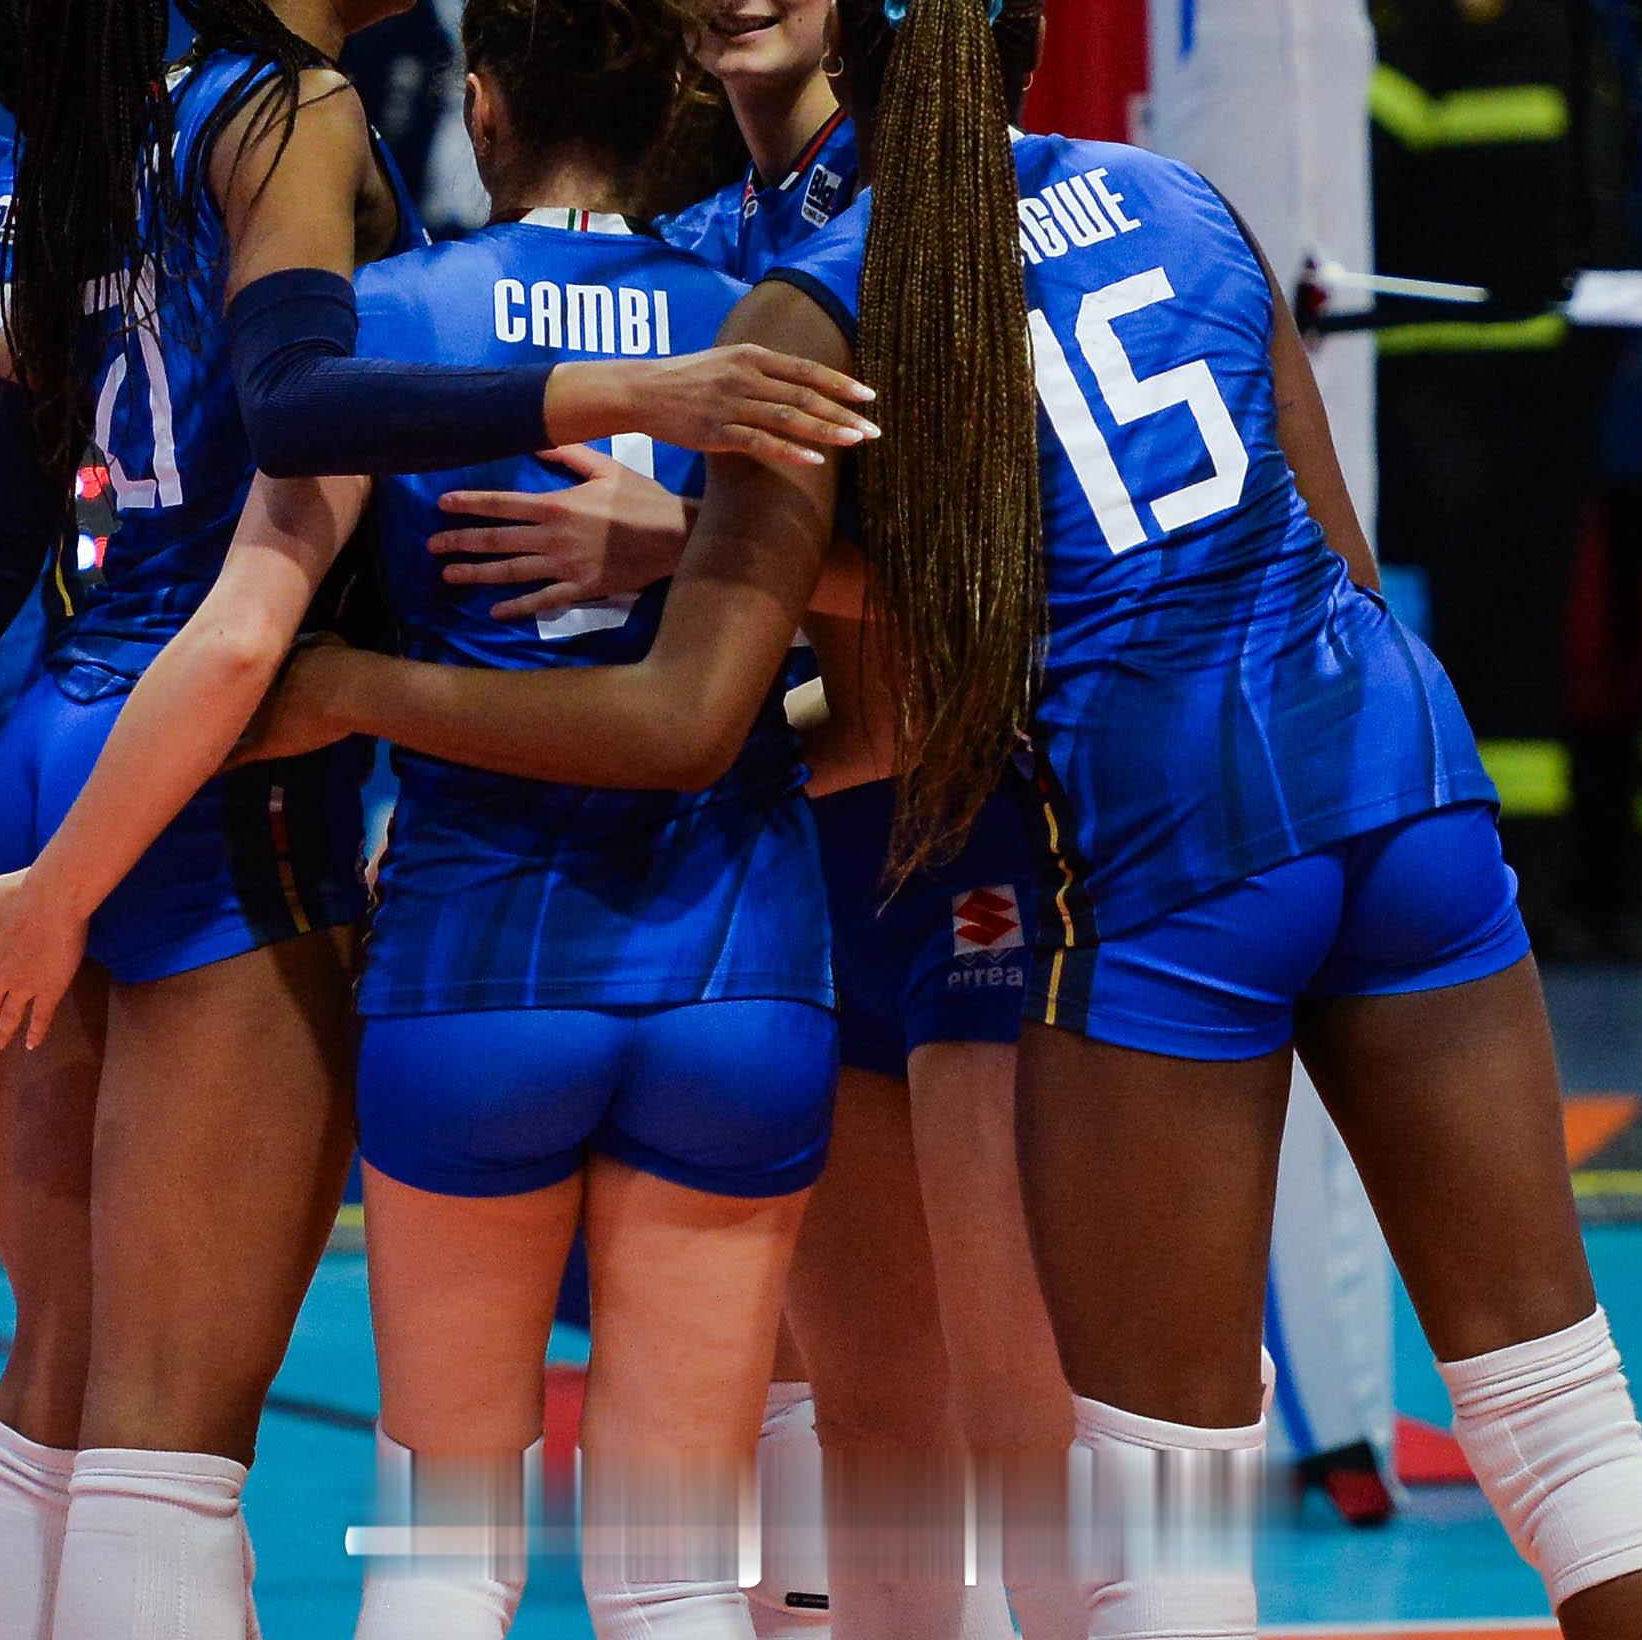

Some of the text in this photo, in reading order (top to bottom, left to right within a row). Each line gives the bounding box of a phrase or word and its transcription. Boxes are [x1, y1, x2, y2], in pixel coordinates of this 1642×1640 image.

[493, 278, 671, 356] CAMBI
[1026, 266, 1250, 556] 15
[947, 965, 1024, 989] errea
